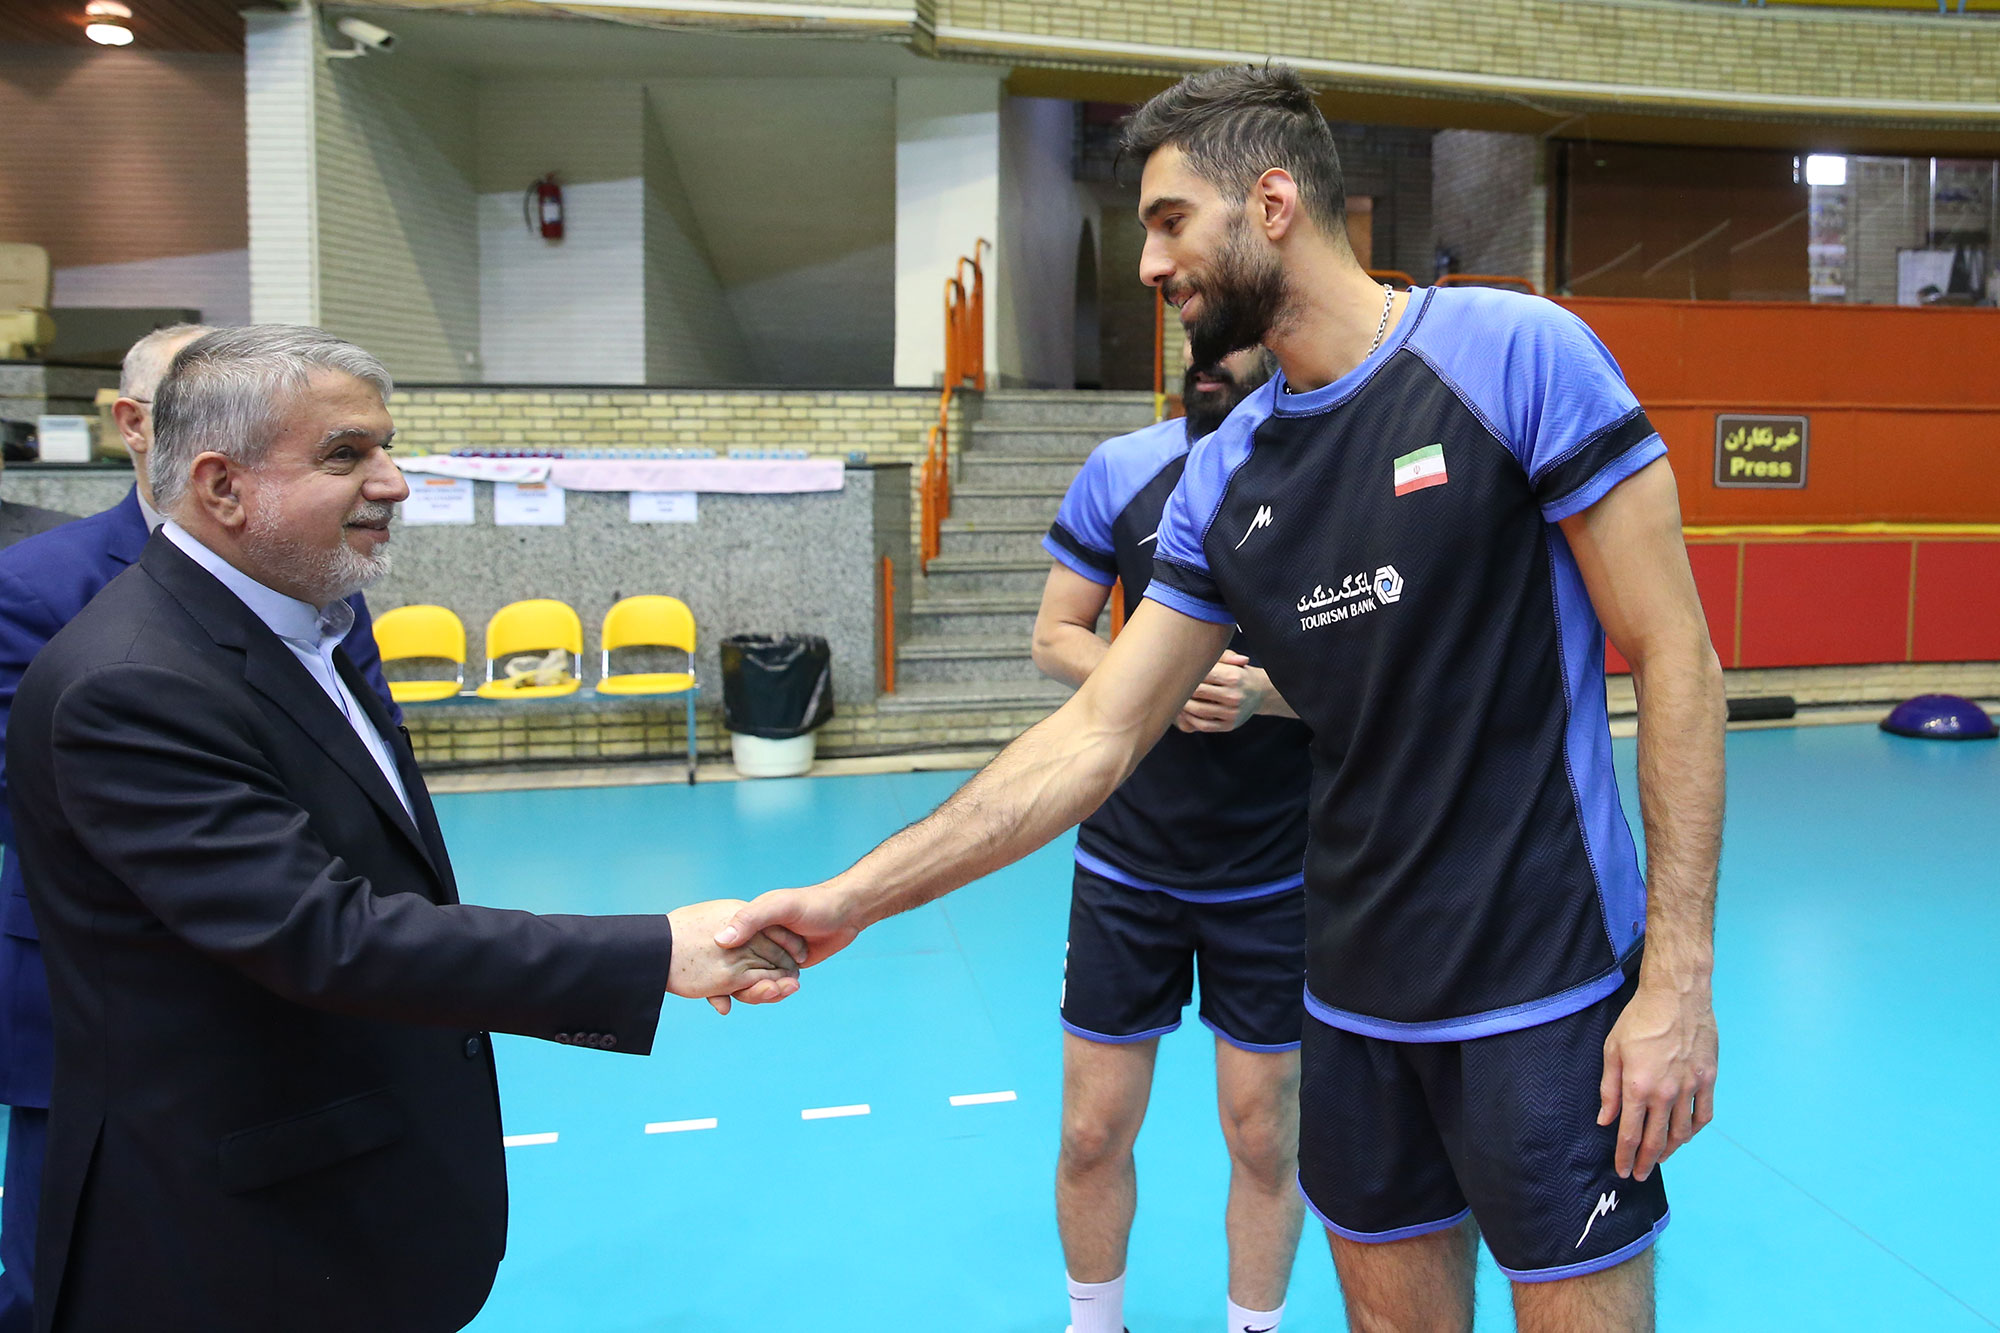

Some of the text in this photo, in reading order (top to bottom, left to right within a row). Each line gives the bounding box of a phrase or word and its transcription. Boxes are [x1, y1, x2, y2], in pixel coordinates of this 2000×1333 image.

[1724, 426, 1800, 452] خبرنگاران
[1730, 456, 1793, 478] Press
[1300, 597, 1378, 632] TOURISM BANK
